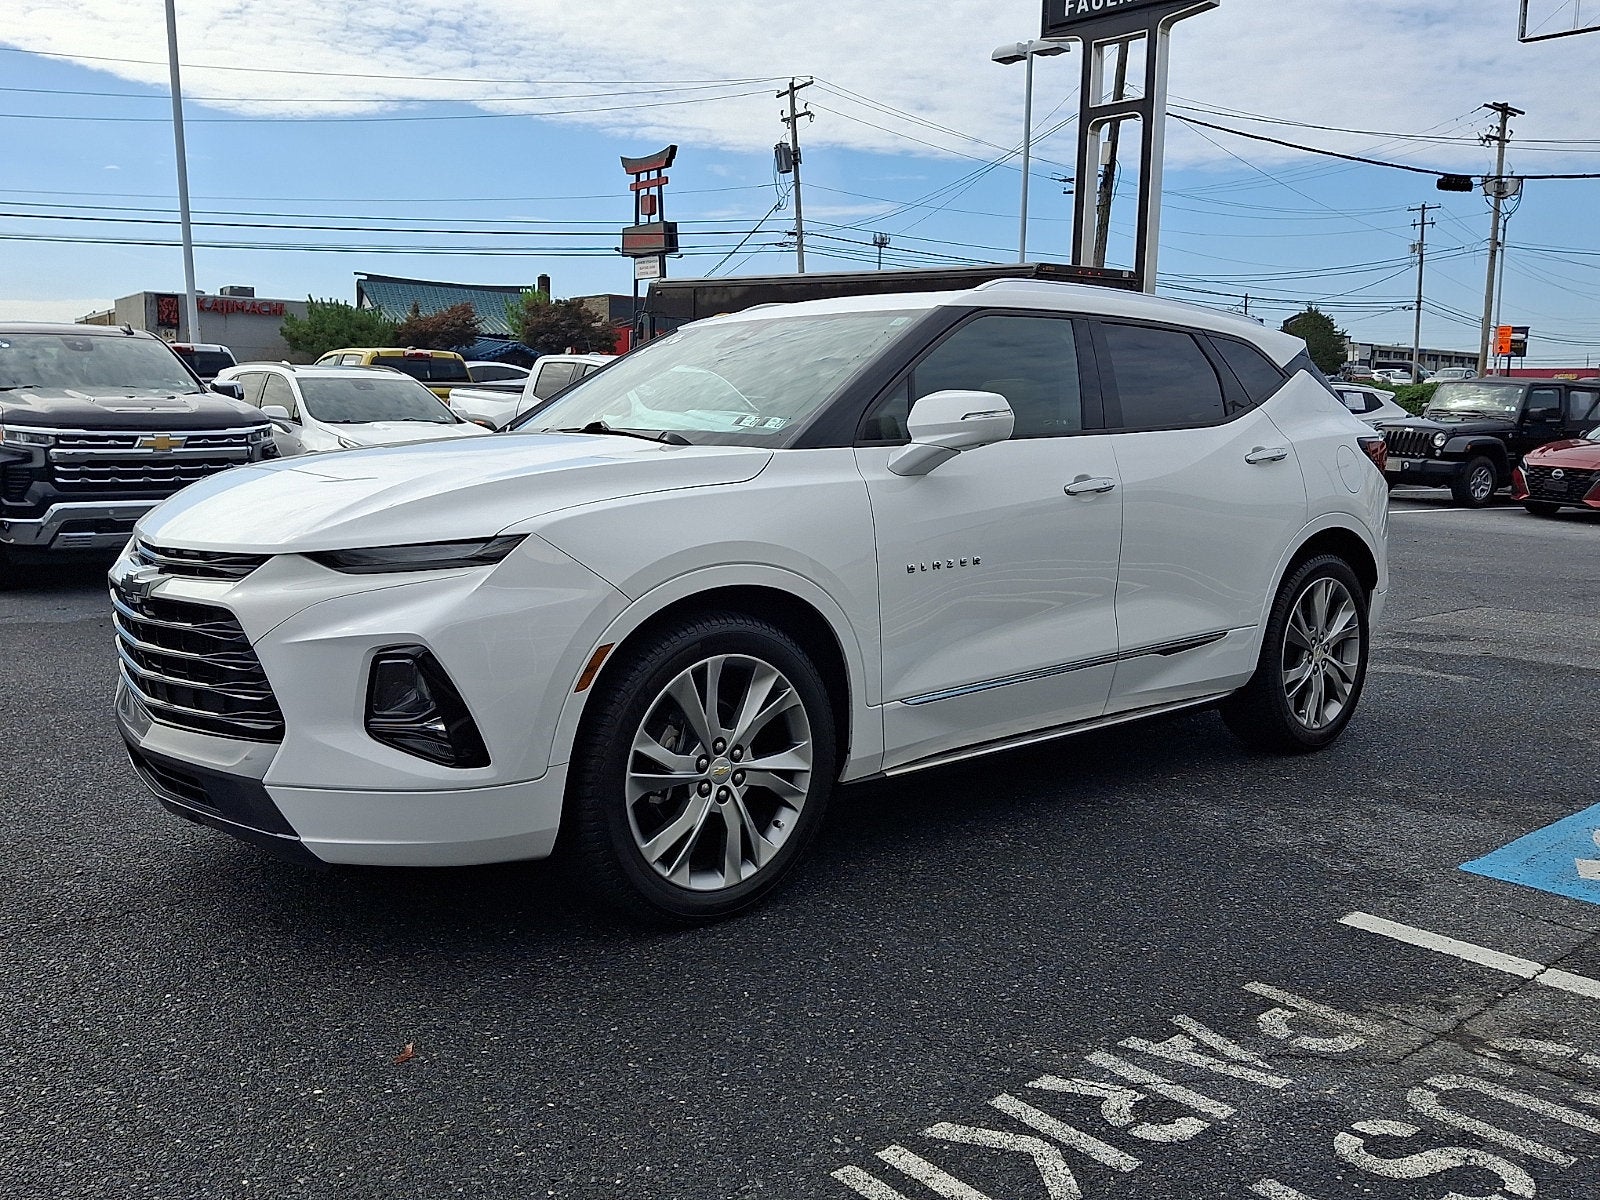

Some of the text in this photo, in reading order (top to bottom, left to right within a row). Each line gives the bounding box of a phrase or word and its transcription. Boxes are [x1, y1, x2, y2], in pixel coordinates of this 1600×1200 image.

[196, 298, 285, 317] KAJIMACHI
[906, 556, 981, 574] BLAZER
[831, 982, 1386, 1200] PARKI
